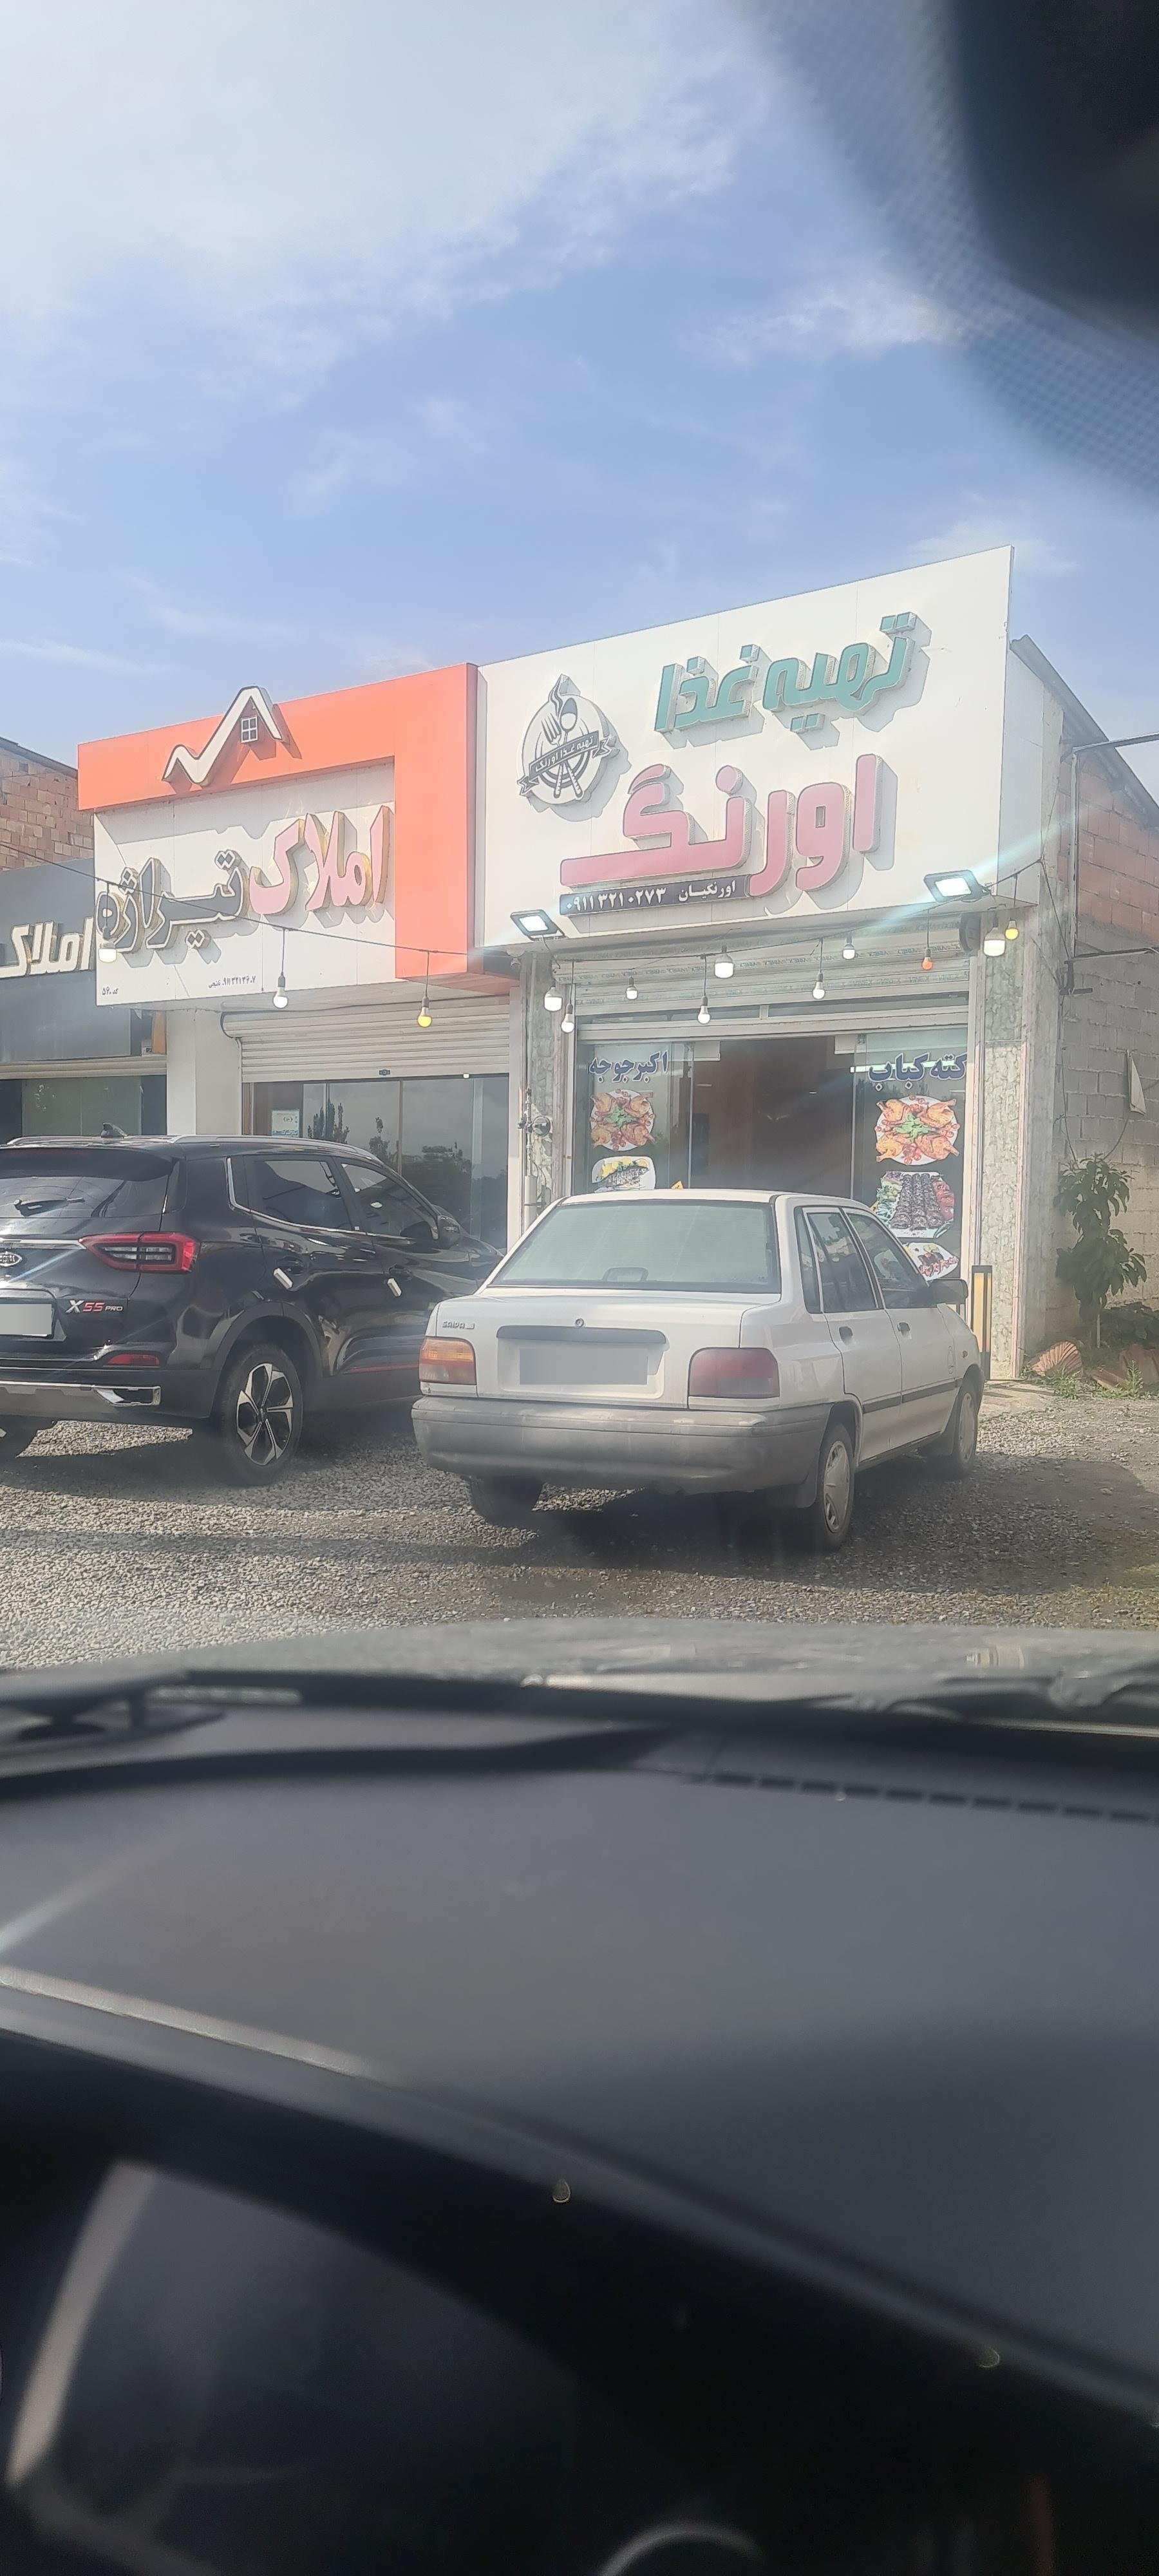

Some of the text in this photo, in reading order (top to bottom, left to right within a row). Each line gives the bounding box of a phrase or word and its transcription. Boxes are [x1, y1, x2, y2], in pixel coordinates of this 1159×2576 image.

[654, 612, 917, 733] تهیه غذا
[560, 753, 883, 898] اورنگ
[97, 805, 391, 954] املاک تیراژه
[0, 916, 94, 978] املاک
[868, 1052, 930, 1092] کباب
[66, 1300, 105, 1313] X55
